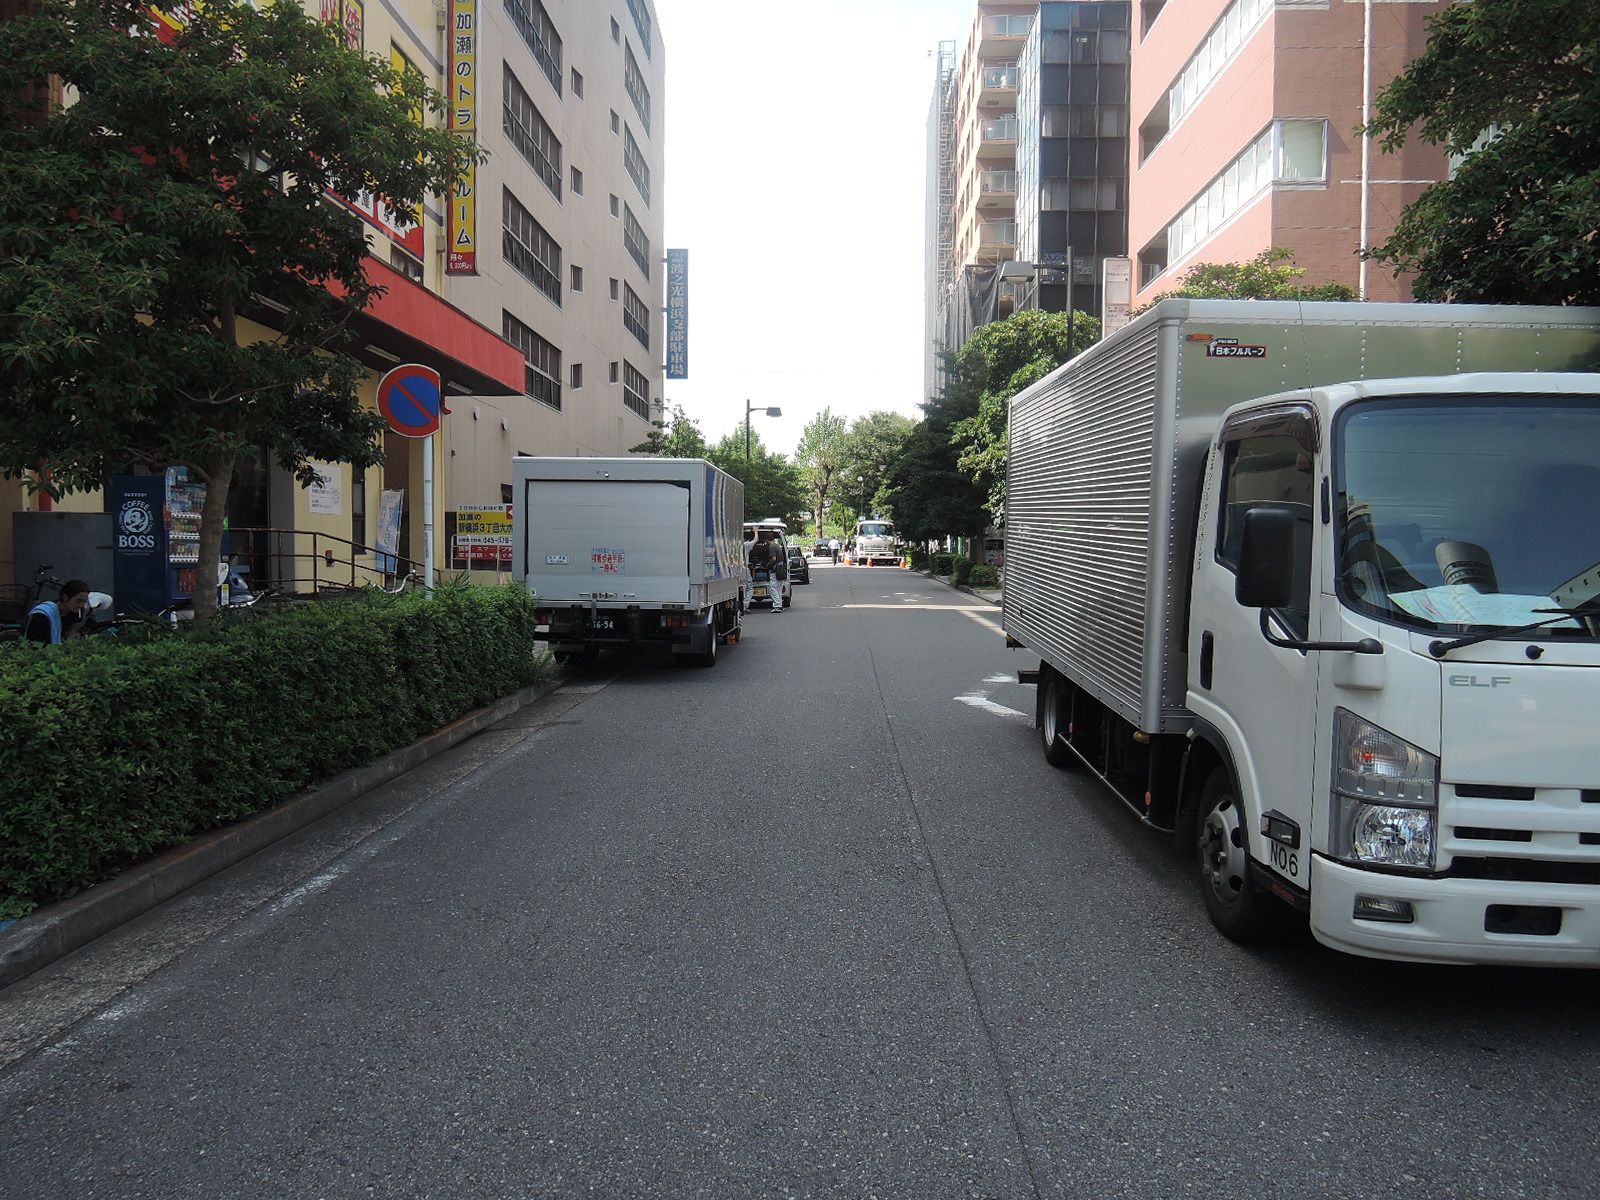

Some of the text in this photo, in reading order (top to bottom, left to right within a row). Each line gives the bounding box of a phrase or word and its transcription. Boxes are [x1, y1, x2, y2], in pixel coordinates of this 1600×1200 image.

[1216, 346, 1265, 356] 日本フルハーフ
[122, 500, 150, 511] COFFEE
[118, 535, 155, 548] BOSS
[1448, 675, 1512, 688] ELF
